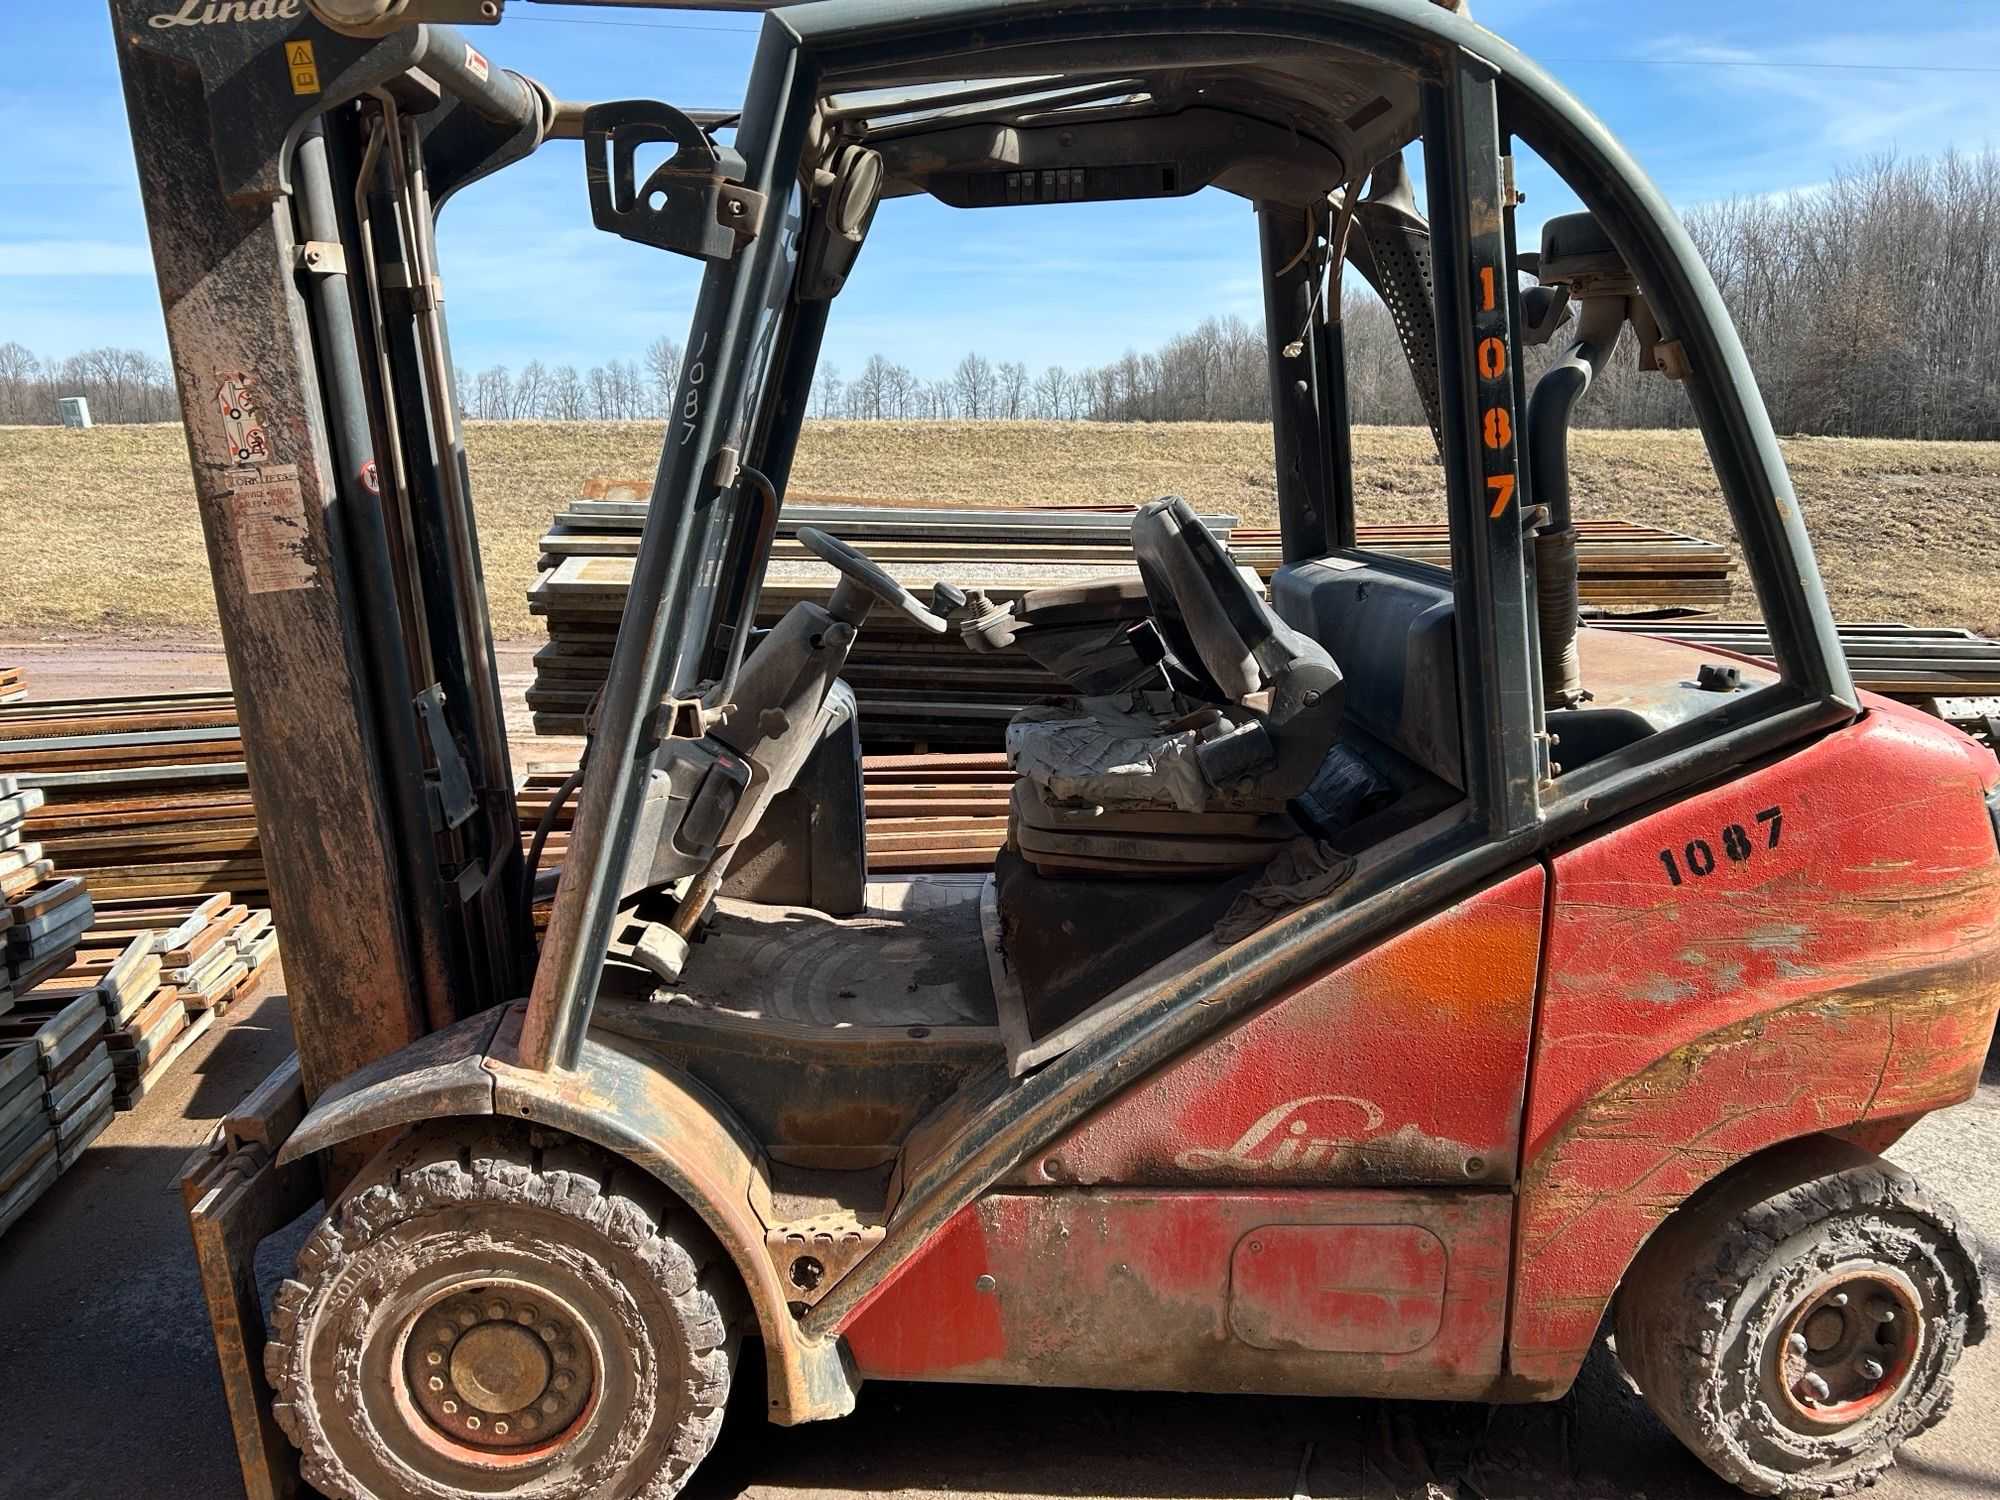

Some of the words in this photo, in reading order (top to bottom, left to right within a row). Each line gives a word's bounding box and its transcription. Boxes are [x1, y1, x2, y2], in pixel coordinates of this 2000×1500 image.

[147, 0, 301, 28] Linde
[681, 331, 708, 445] 1087
[1477, 266, 1516, 519] 1087
[1659, 805, 1783, 886] 1087
[1174, 1094, 1420, 1170] Lin
